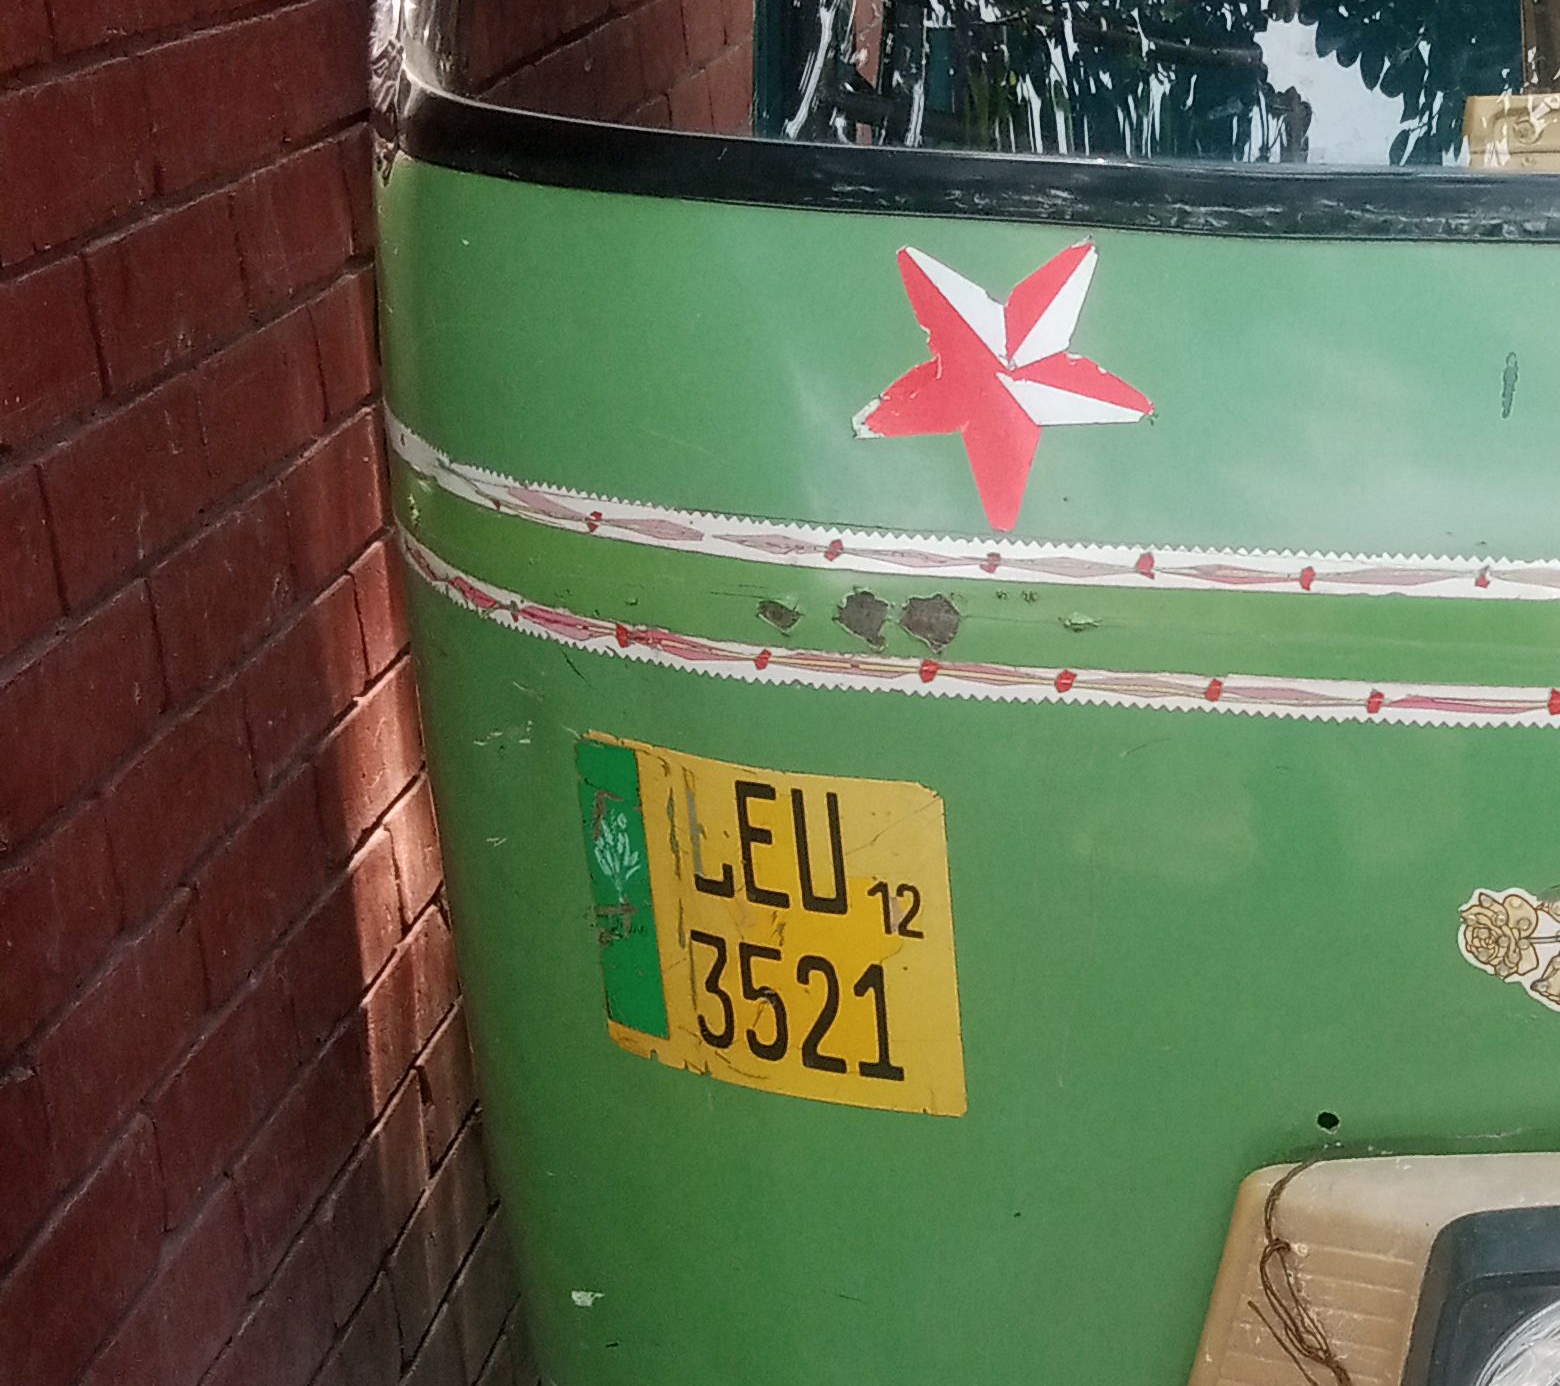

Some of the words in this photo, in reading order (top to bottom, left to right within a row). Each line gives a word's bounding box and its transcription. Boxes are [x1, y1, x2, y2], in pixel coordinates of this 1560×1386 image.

[686, 779, 848, 915] LEU
[867, 880, 925, 940] 12
[689, 929, 905, 1082] 3521
